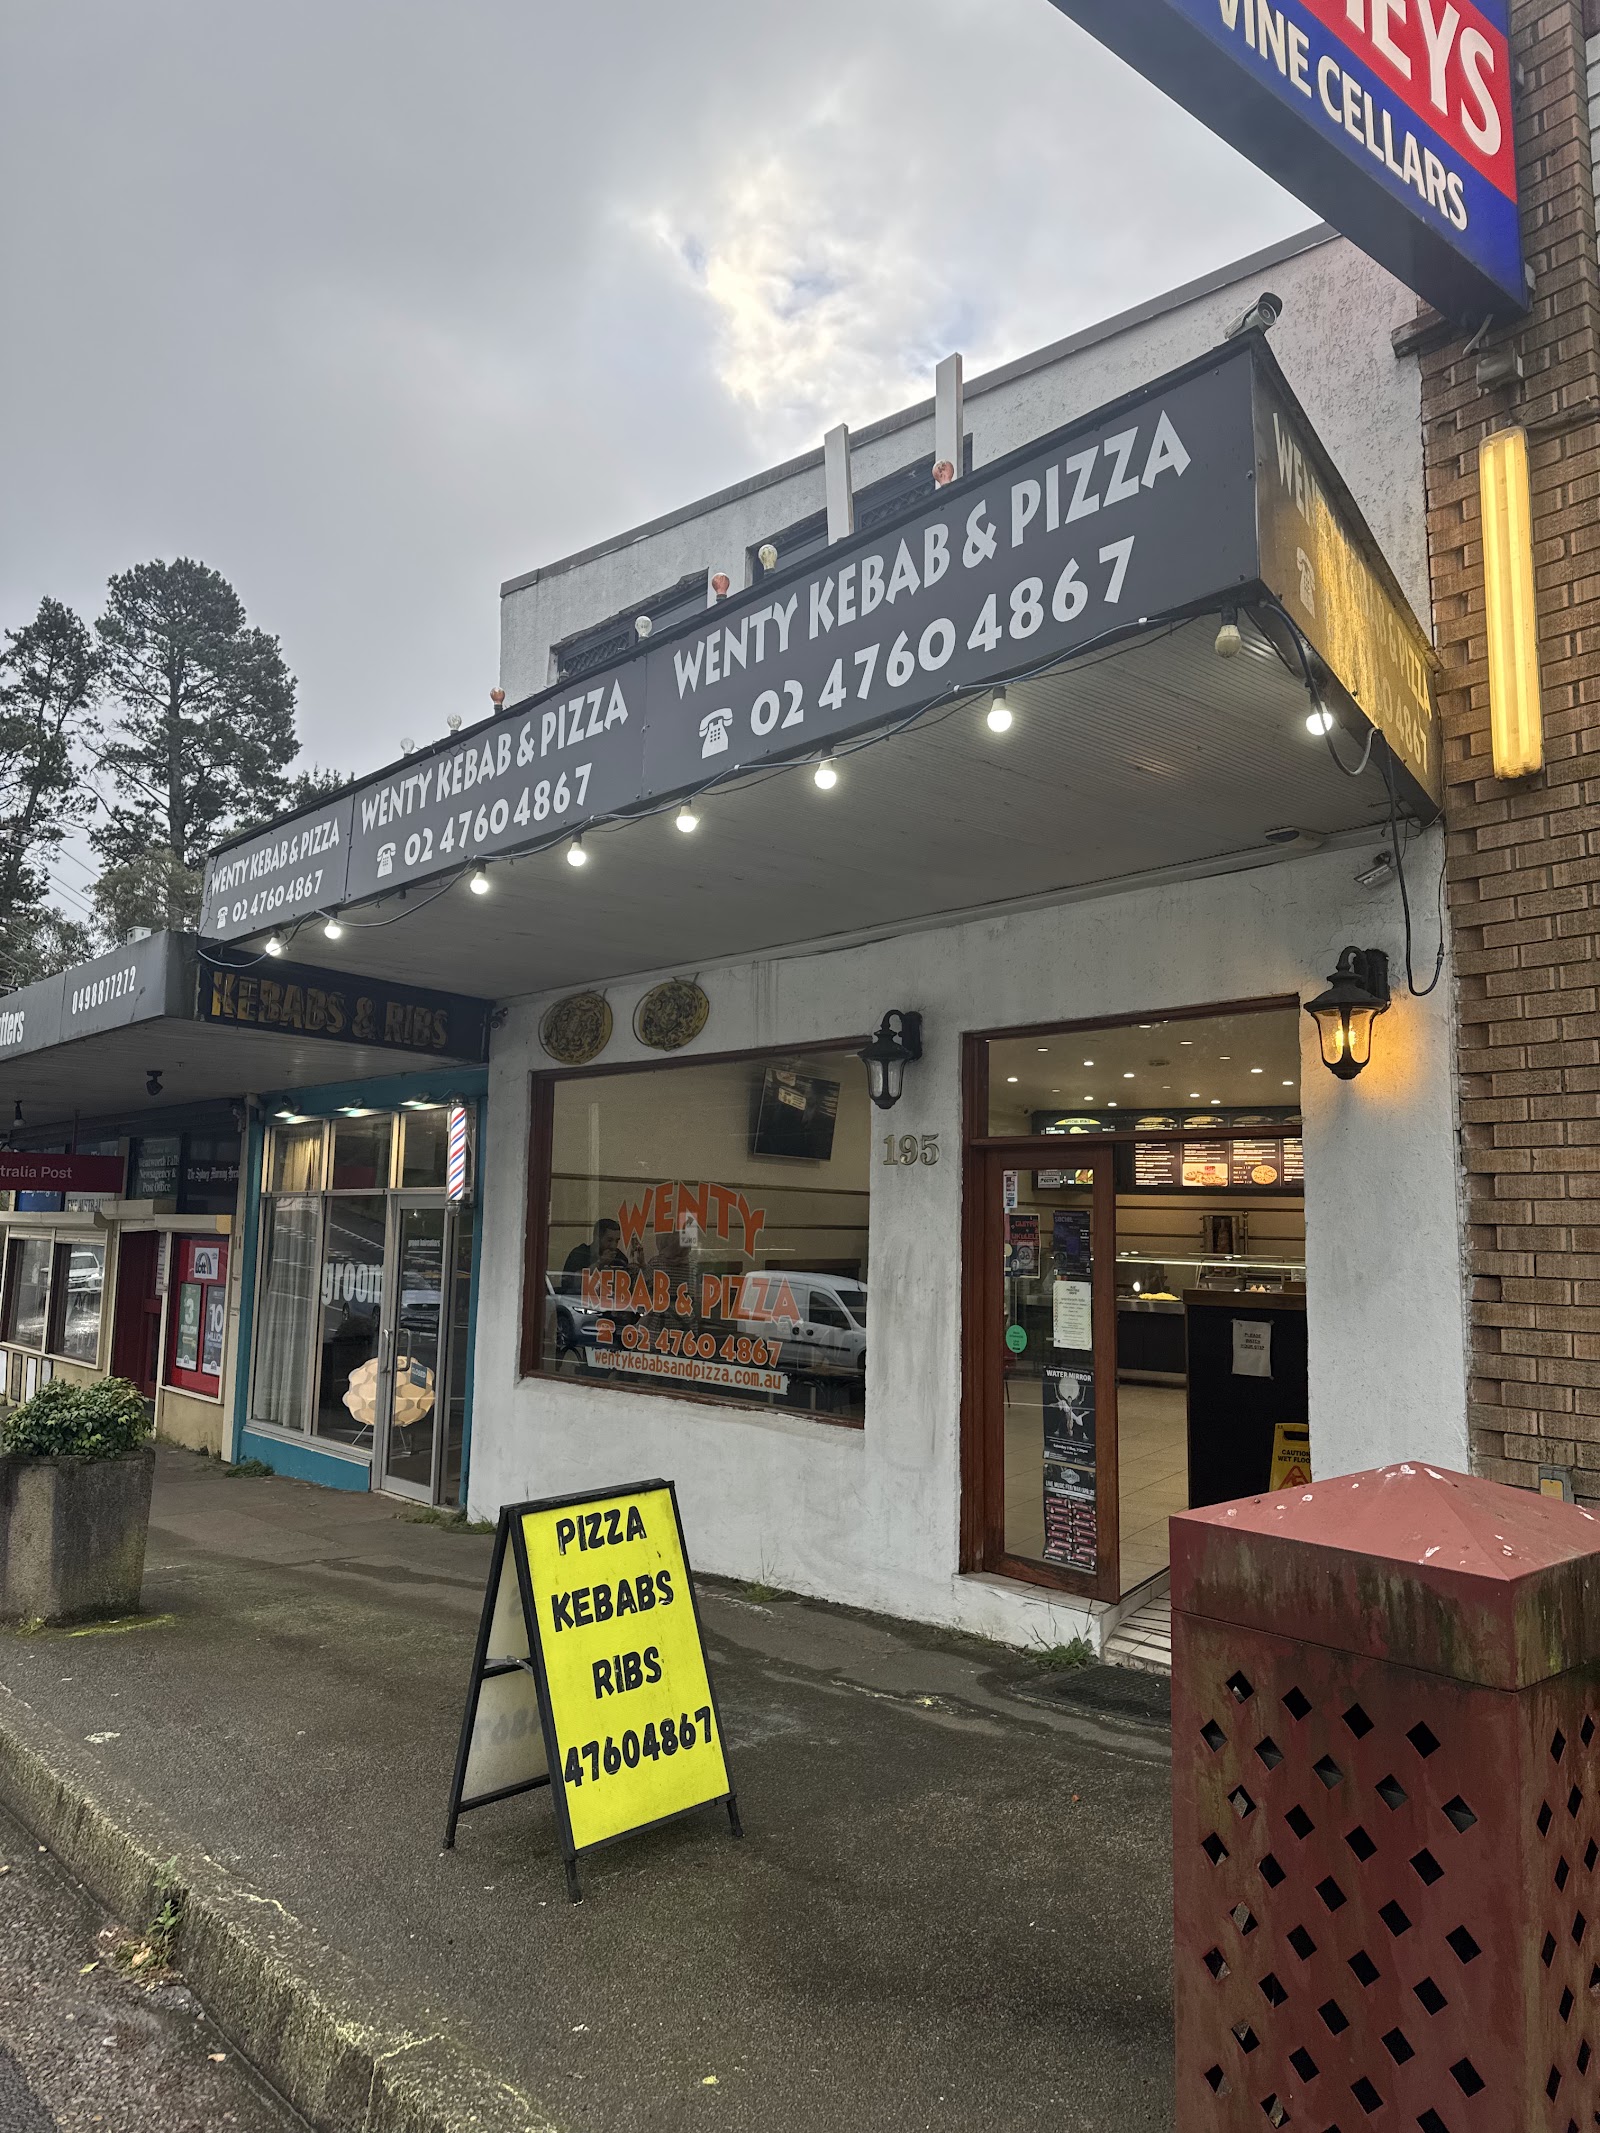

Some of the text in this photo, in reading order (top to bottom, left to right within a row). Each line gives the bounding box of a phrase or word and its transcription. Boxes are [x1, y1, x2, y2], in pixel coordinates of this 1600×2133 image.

[1318, 55, 1468, 231] CELLARS
[674, 410, 1192, 699] WENTY KEBAB & PIZZA
[750, 535, 1136, 737] 02 4760 4867
[1397, 625, 1432, 720] PIZZA
[361, 678, 629, 835] WENTY KEBAB & PIZZA
[1396, 694, 1428, 774] 4867
[404, 762, 593, 866] 02 4760 4867
[212, 817, 340, 897] WENTY KEBAB & PIZZA
[232, 869, 324, 922] 02 4760 4867
[72, 965, 136, 1015] 0498877272
[211, 971, 449, 1048] KEBABS & RIBS
[41, 1166, 73, 1180] Post
[883, 1133, 940, 1166] 195
[618, 1180, 766, 1261] WENTY
[581, 1268, 800, 1326] KEBAB & PIZZA
[595, 1351, 781, 1390] wentykebabsandpizza.com.au
[621, 1325, 783, 1368] 02 4760 4867
[1046, 1370, 1092, 1382] WATER MIRROR
[556, 1505, 647, 1556] PIZZA
[550, 1569, 674, 1632] KEBABS
[592, 1646, 662, 1699] RIBS
[564, 1705, 713, 1787] 47604867
